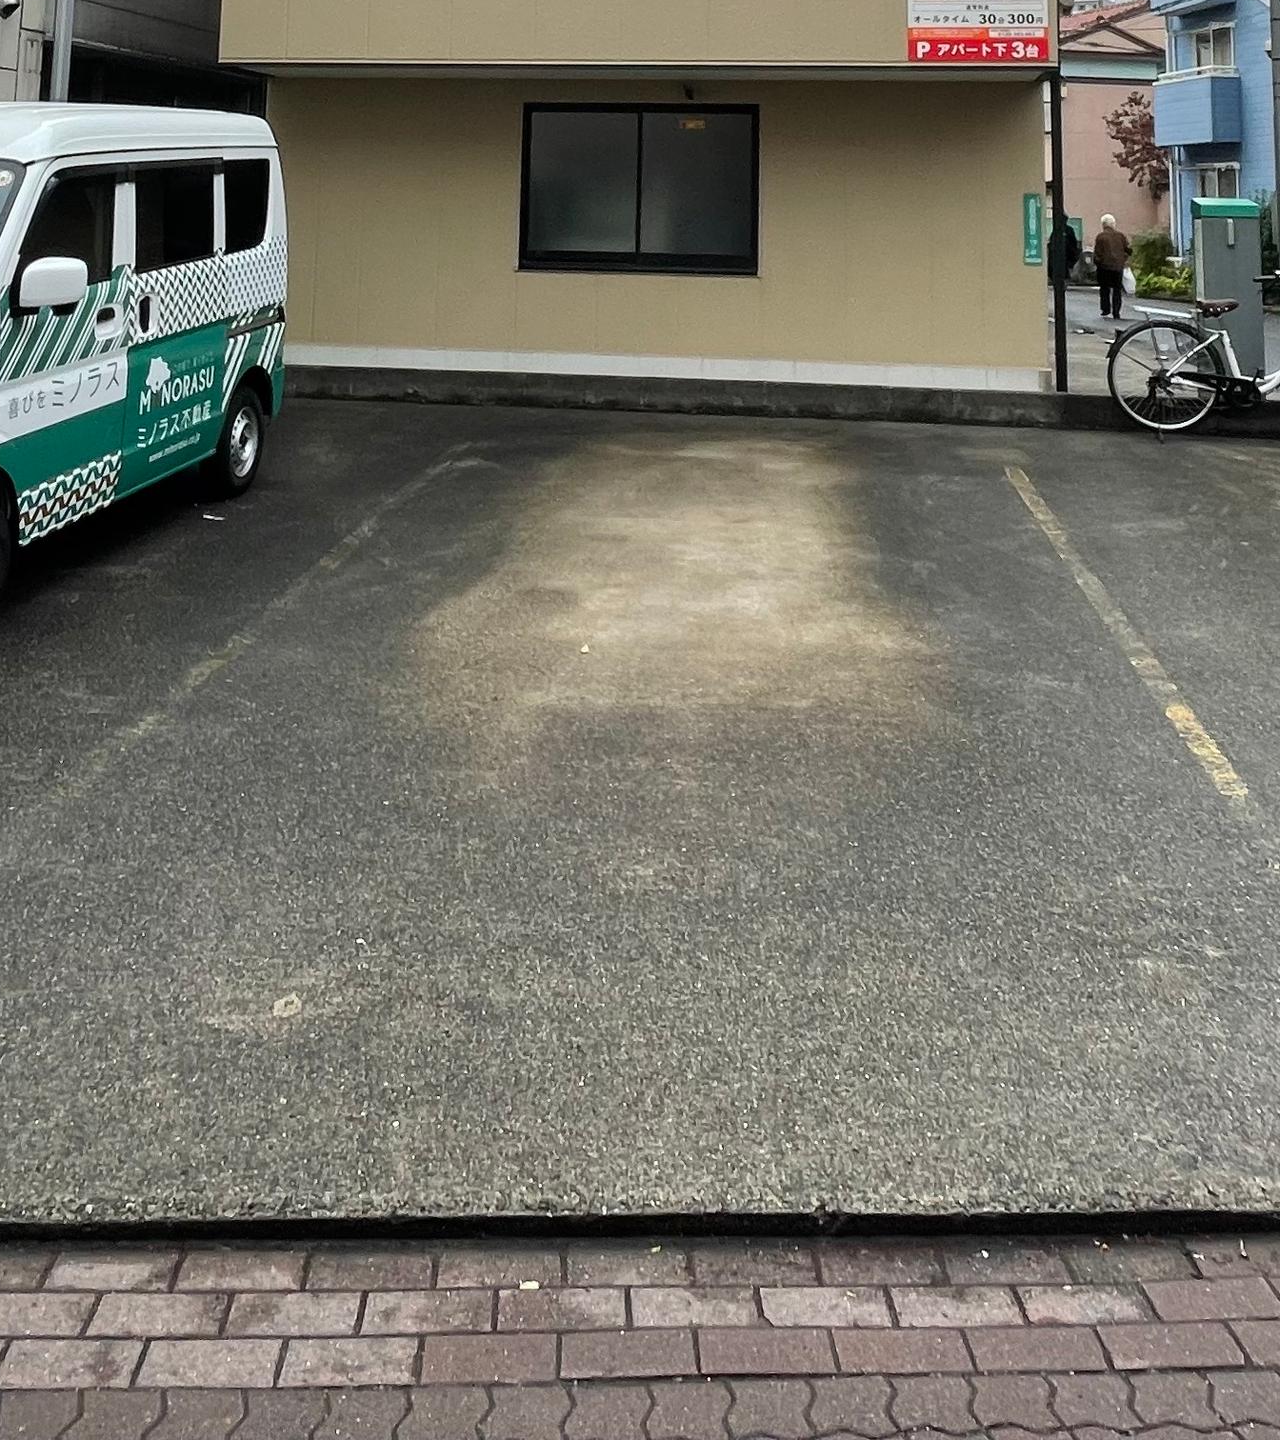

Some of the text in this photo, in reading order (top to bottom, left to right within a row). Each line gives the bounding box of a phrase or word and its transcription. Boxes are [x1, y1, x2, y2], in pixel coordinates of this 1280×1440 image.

[913, 15, 970, 24] オールタイム
[916, 41, 931, 59] P
